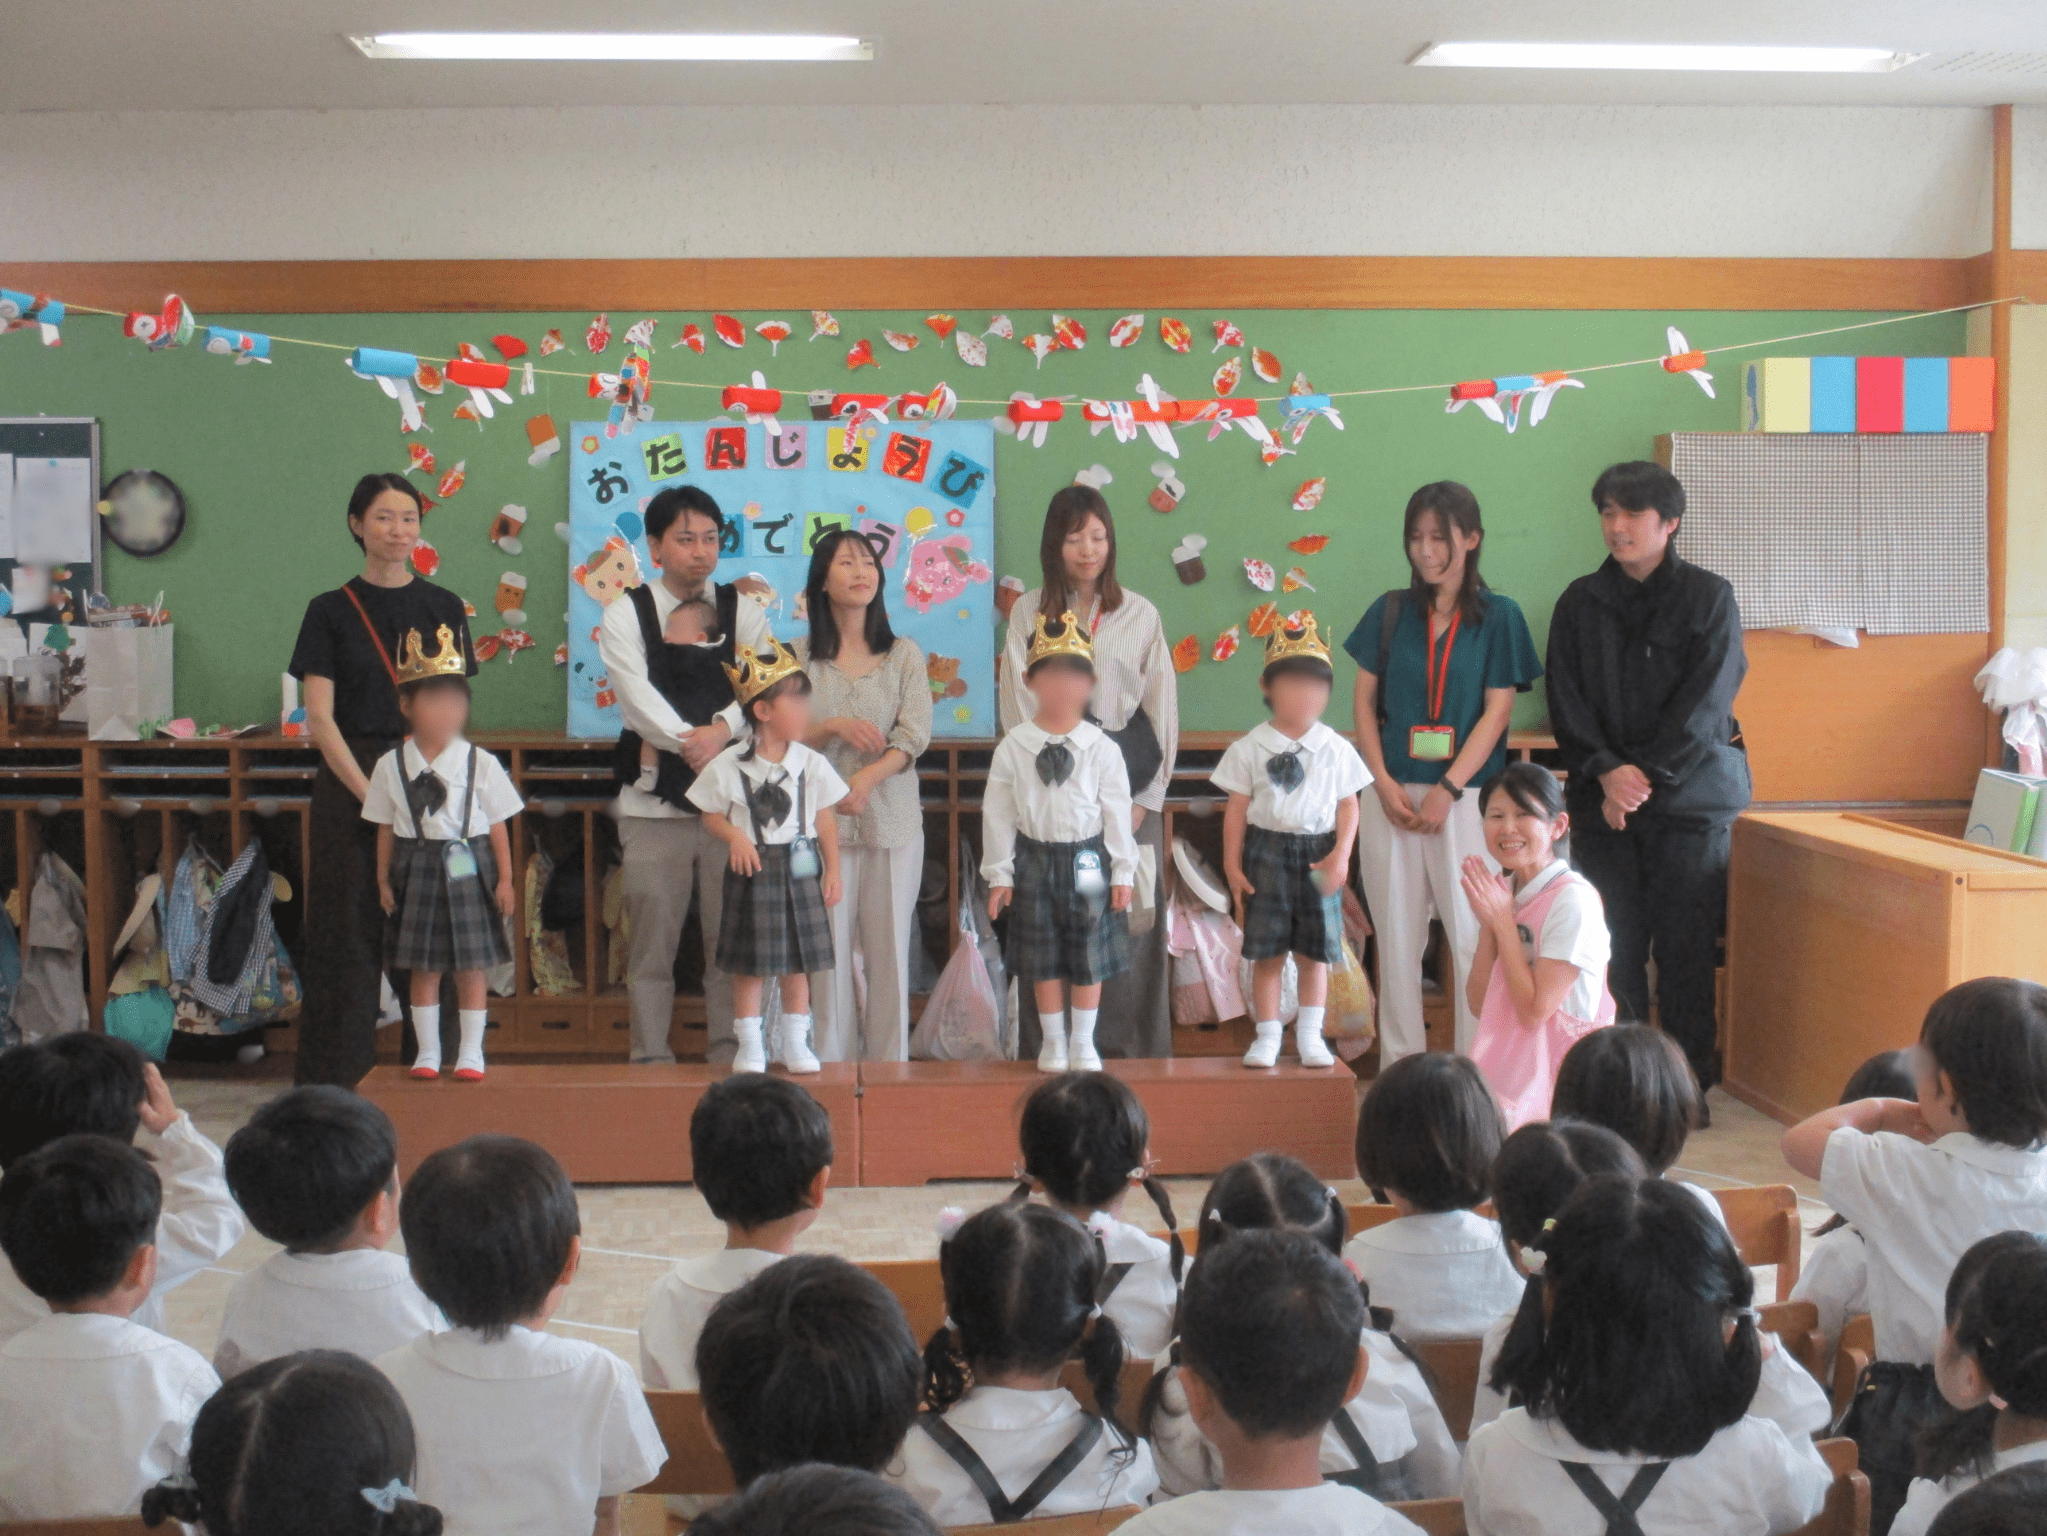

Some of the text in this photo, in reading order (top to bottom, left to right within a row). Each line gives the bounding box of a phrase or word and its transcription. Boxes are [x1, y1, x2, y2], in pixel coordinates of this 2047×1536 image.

[587, 430, 985, 504] おたんじょうび
[718, 512, 897, 561] めでとう
